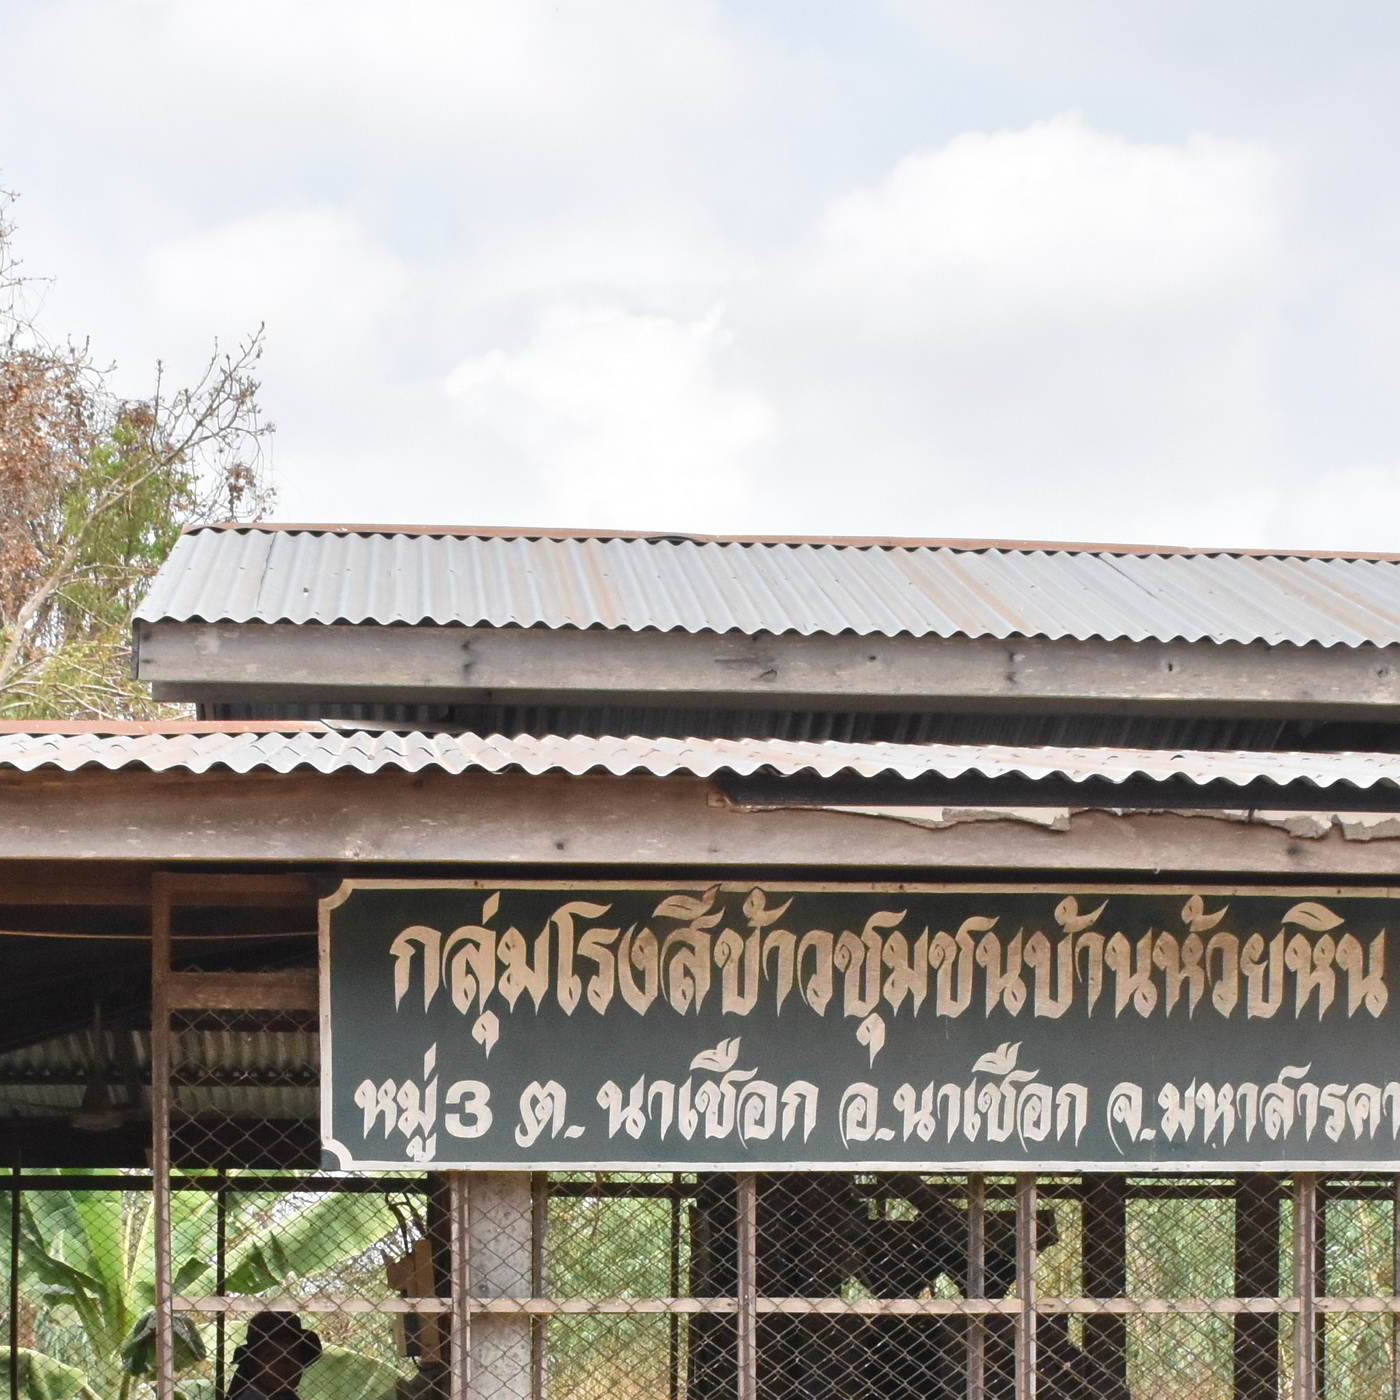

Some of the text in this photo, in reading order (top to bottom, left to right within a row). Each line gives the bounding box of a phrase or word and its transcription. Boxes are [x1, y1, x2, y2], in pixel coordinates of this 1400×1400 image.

[389, 883, 1389, 1069] กลุ่มโรงสีข้าวชุมชนบ้านห้วยหิน
